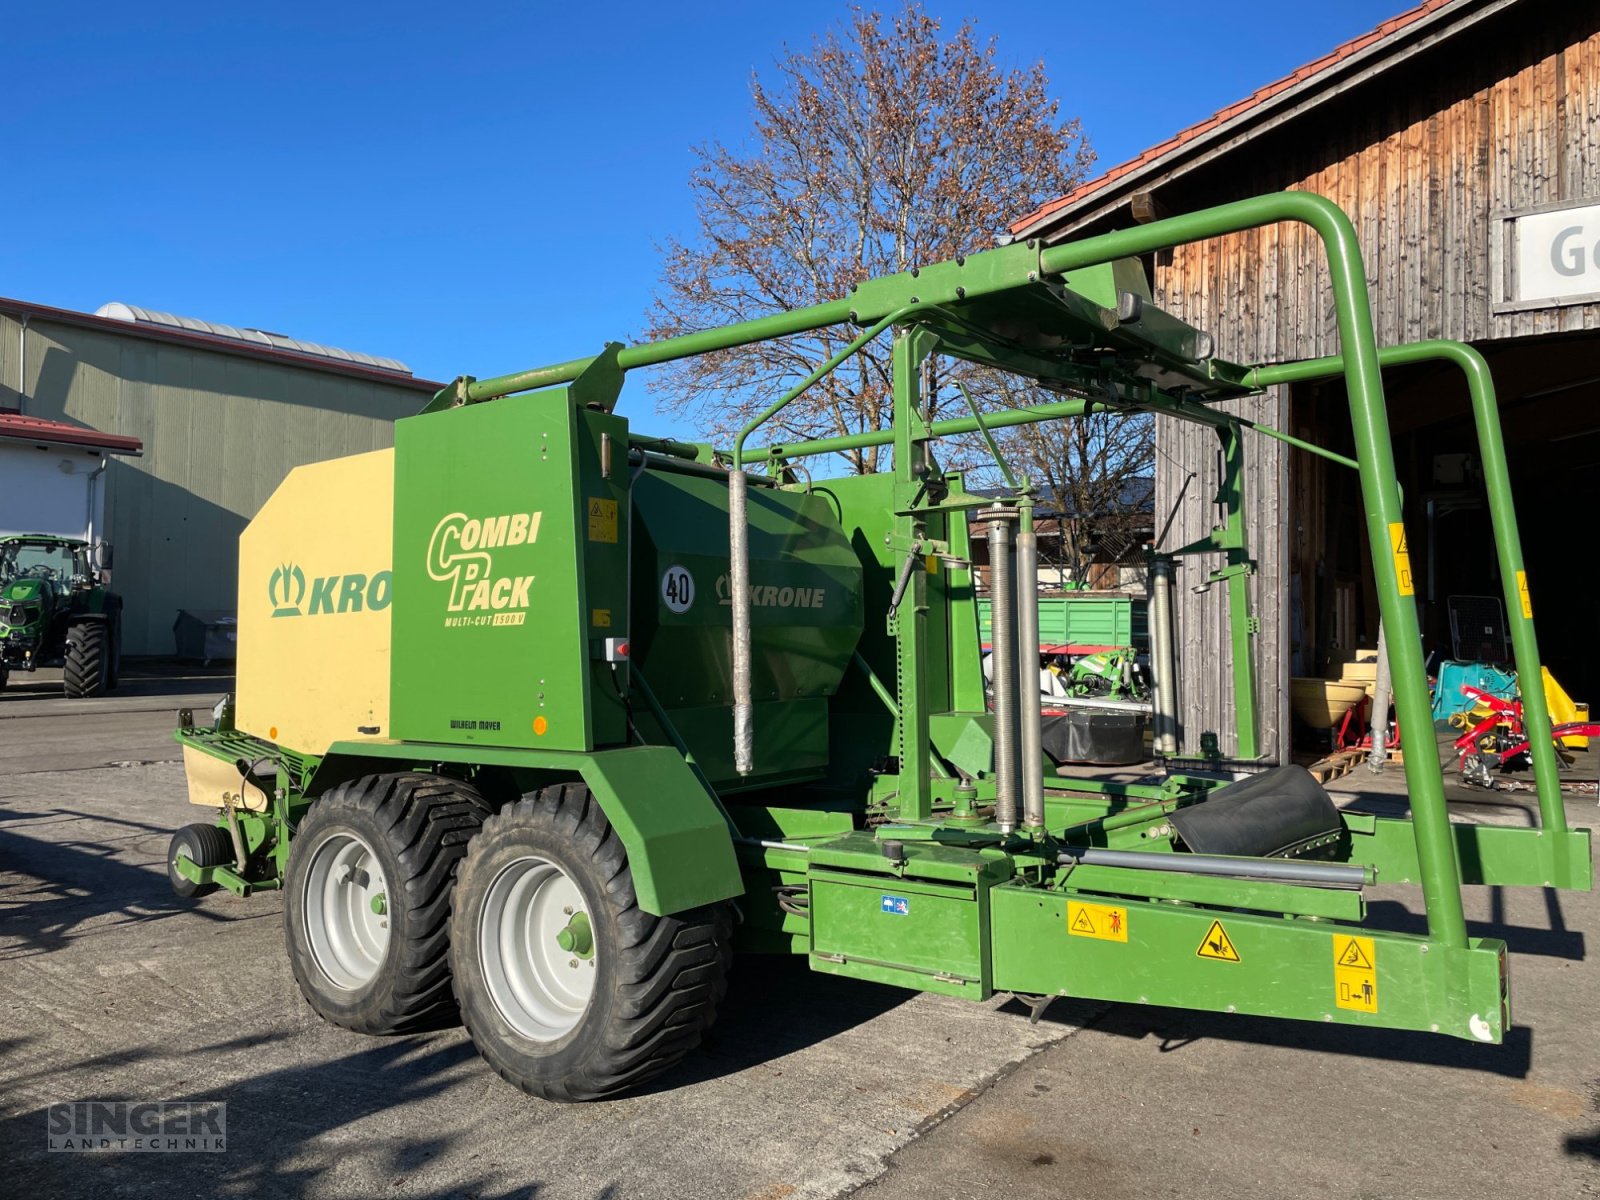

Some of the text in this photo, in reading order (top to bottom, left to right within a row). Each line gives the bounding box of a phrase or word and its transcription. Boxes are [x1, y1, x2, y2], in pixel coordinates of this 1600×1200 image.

[1550, 225, 1600, 277] G
[427, 511, 542, 581] COMBI
[447, 551, 535, 612] PACK
[666, 573, 689, 605] 40
[444, 614, 525, 627] MULTI-CUT 1500 V
[450, 720, 501, 731] WILHELM MAYER
